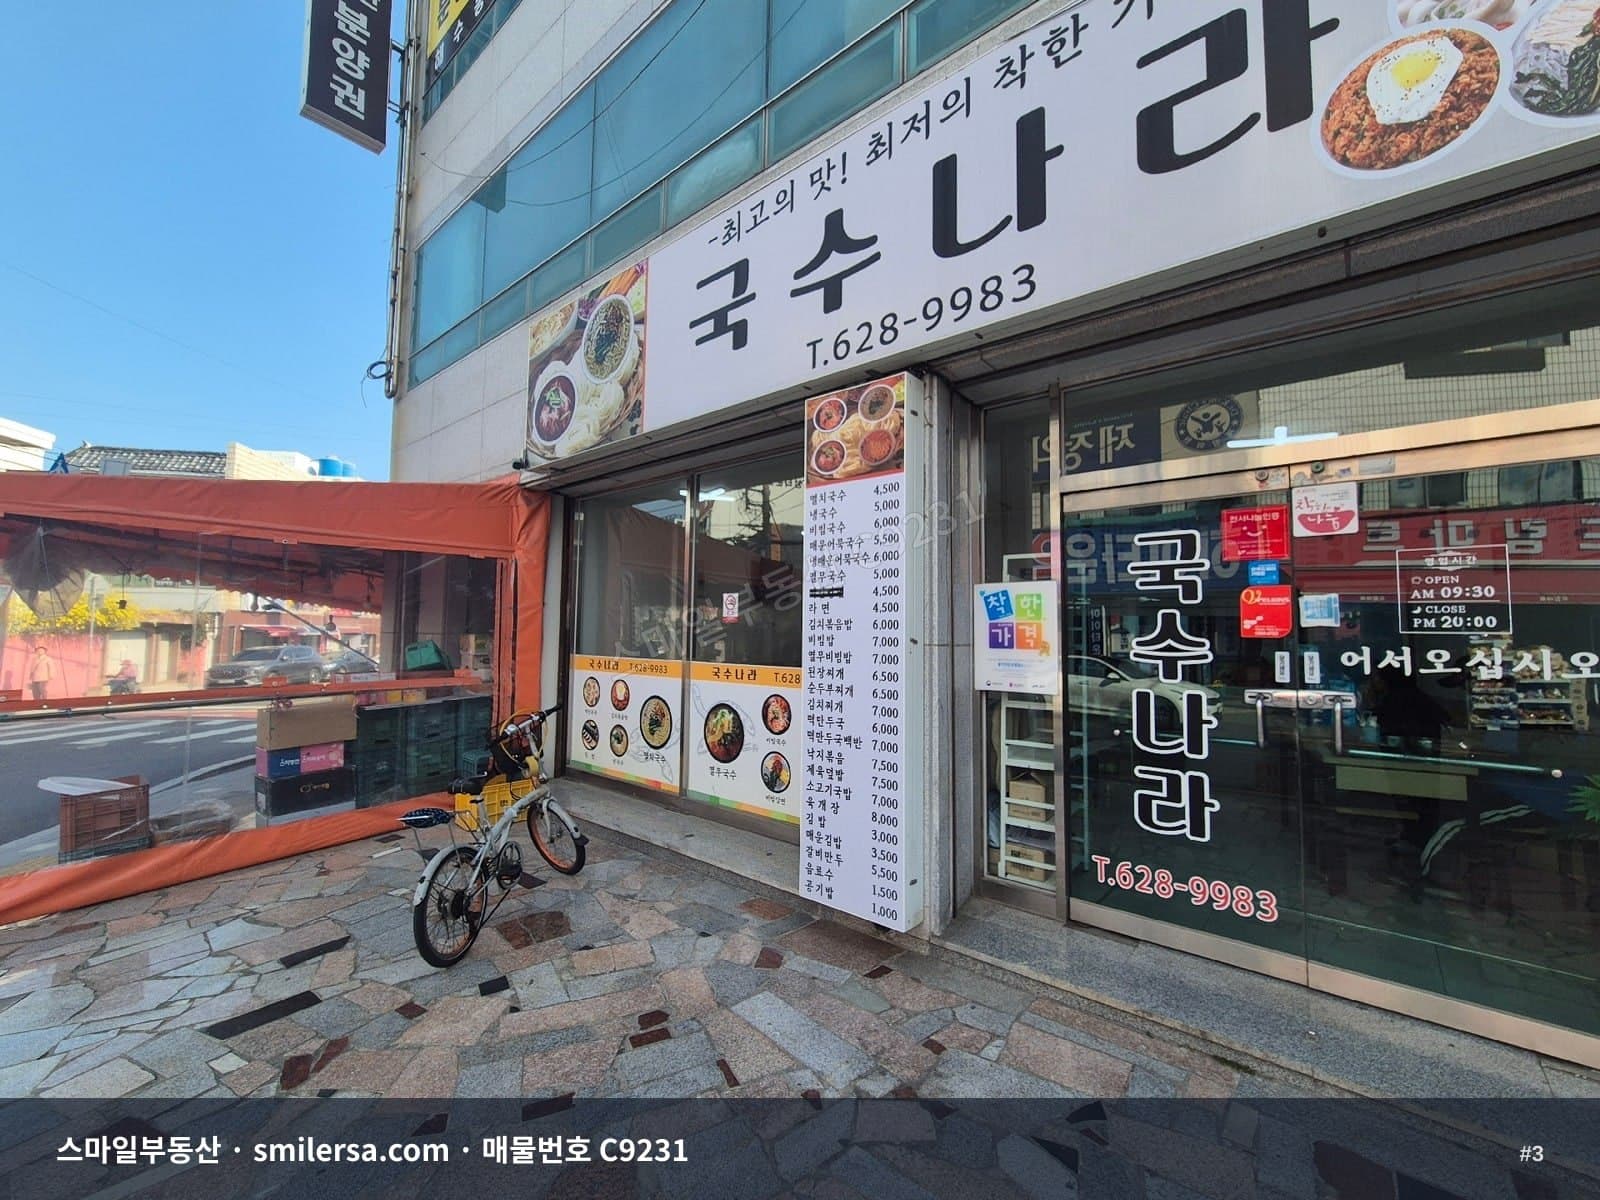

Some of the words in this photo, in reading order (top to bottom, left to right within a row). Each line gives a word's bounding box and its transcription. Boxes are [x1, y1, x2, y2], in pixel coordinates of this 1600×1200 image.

[809, 154, 849, 202] 맛!
[865, 76, 973, 168] 최저의
[993, 13, 1087, 90] 착한
[688, 0, 1339, 350] 국수나라
[806, 263, 1037, 370] T.628-9983
[809, 489, 847, 506] 멸치국수
[873, 482, 900, 496] 4,500
[809, 506, 838, 521] 냉국수
[874, 498, 900, 512] 5,000
[809, 521, 846, 536] 비빔국수
[874, 515, 900, 529] 6,000
[873, 533, 900, 546] 5,500
[873, 550, 900, 562] 6,000
[1423, 555, 1478, 566] 영업시간
[873, 568, 899, 580] 5,000
[1424, 575, 1460, 585] OPEN
[873, 585, 899, 597] 4,500
[1411, 590, 1435, 599] AM
[1440, 585, 1496, 599] 09:30
[872, 602, 899, 613] 4,500
[987, 593, 1041, 617] 착한
[1425, 605, 1467, 615] CLOSE
[808, 618, 853, 631] 김치볶음밥
[872, 619, 899, 630] 6,000
[1412, 617, 1436, 628] PM
[1440, 615, 1498, 629] 20:00
[808, 633, 835, 647] 비빔밥
[872, 636, 899, 648] 7,000
[990, 623, 1038, 649] 가격
[588, 658, 620, 671] 국수나라
[808, 649, 852, 664] 열무비빔밥
[872, 653, 899, 665] 7,000
[1340, 645, 1600, 681] 어서오십시오
[711, 666, 757, 681] 국수나라
[872, 671, 899, 683] 6,500
[1127, 529, 1221, 843] 국수나라
[872, 688, 899, 701] 6,500
[872, 705, 899, 719] 7,000
[872, 723, 898, 736] 6,000
[872, 740, 898, 754] 7,000
[807, 747, 845, 765] 낙지볶음
[872, 759, 898, 773] 7,500
[806, 764, 845, 782] 제육덮밥
[872, 776, 898, 791] 7,500
[806, 780, 852, 801] 소고기국밥
[871, 794, 898, 810] 7,000
[871, 811, 898, 828] 8,000
[871, 829, 898, 846] 3,000
[805, 829, 842, 850] 매운김밥
[871, 847, 898, 864] 3,500
[805, 845, 843, 867] 갈비만두
[871, 864, 898, 882] 5,500
[805, 862, 834, 881] 음료수
[871, 884, 898, 901] 1,500
[1091, 854, 1279, 924] T.628-9983
[805, 880, 834, 900] 공기밥
[871, 903, 898, 921] 1,000
